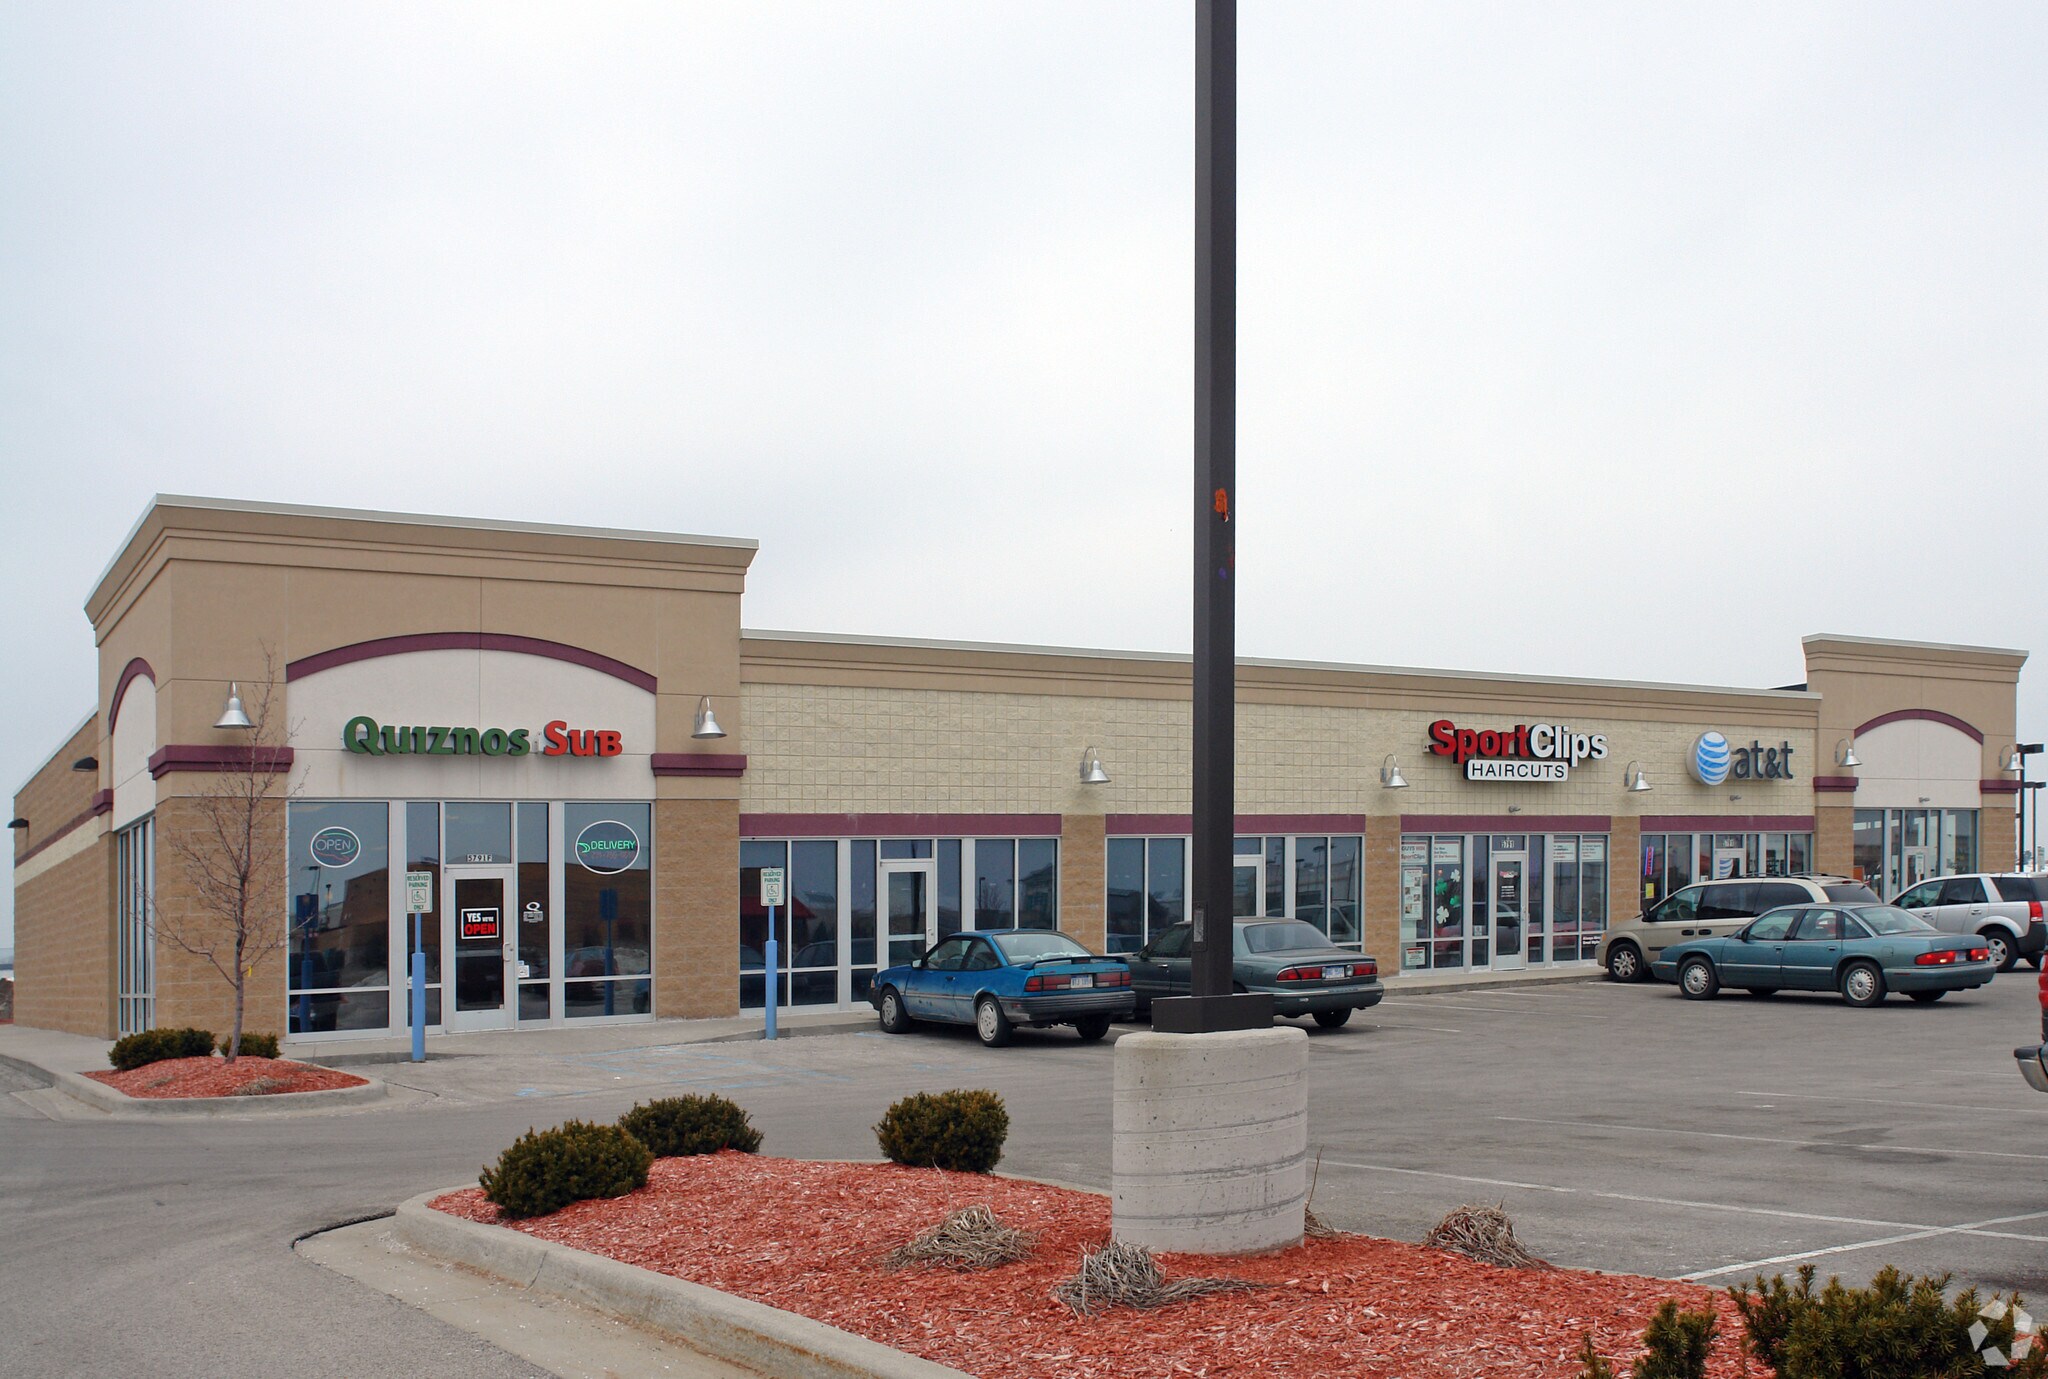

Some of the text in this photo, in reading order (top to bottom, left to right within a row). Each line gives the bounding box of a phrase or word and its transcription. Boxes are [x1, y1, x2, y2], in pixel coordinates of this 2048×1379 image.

[1734, 740, 1794, 779] at&t
[1472, 763, 1565, 778] HAIRCUTS
[315, 839, 351, 851] OPEN
[590, 840, 636, 850] DELIVERY
[466, 913, 481, 922] YES
[464, 923, 496, 935] OPEN
